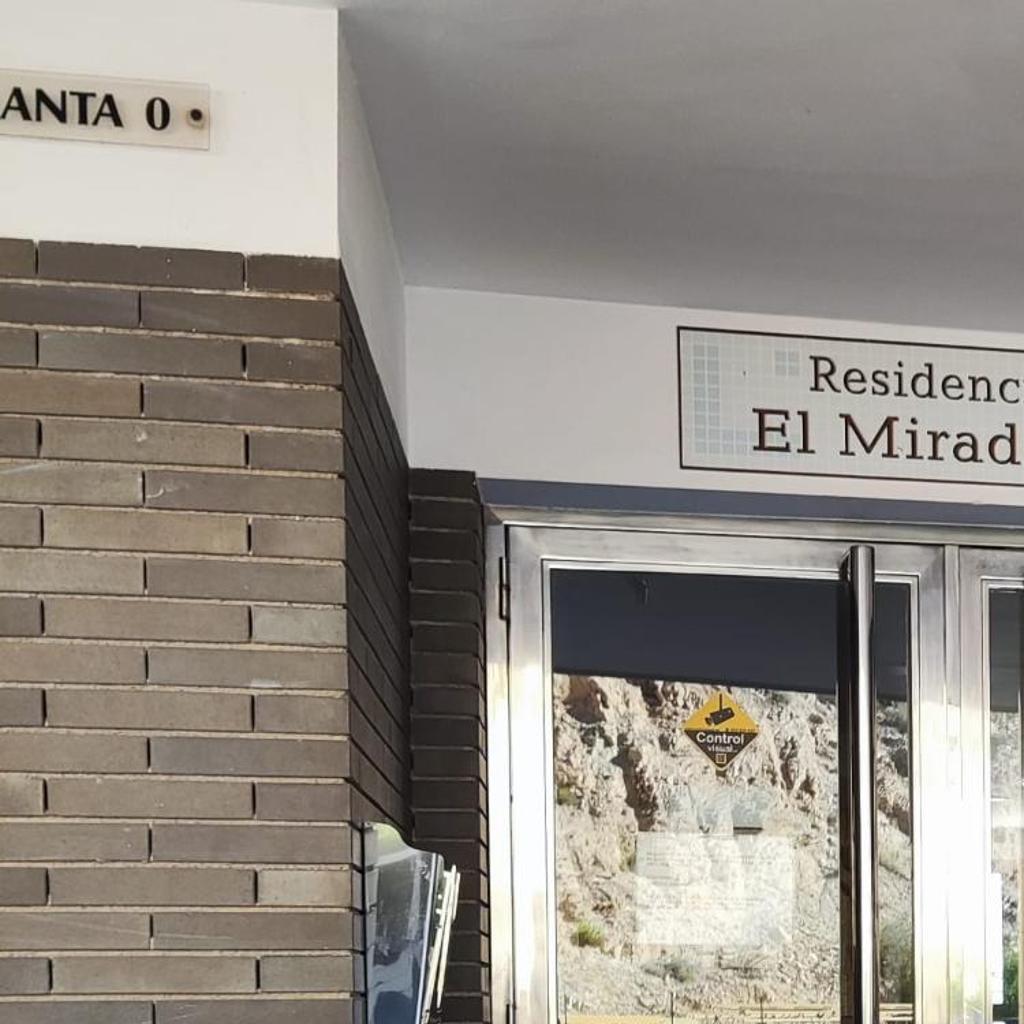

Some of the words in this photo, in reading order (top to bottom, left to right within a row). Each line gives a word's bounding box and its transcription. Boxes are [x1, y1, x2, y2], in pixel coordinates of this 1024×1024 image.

[0, 87, 124, 128] ANTA
[146, 97, 171, 131] 0
[752, 408, 816, 455] El
[696, 732, 745, 745] Control
